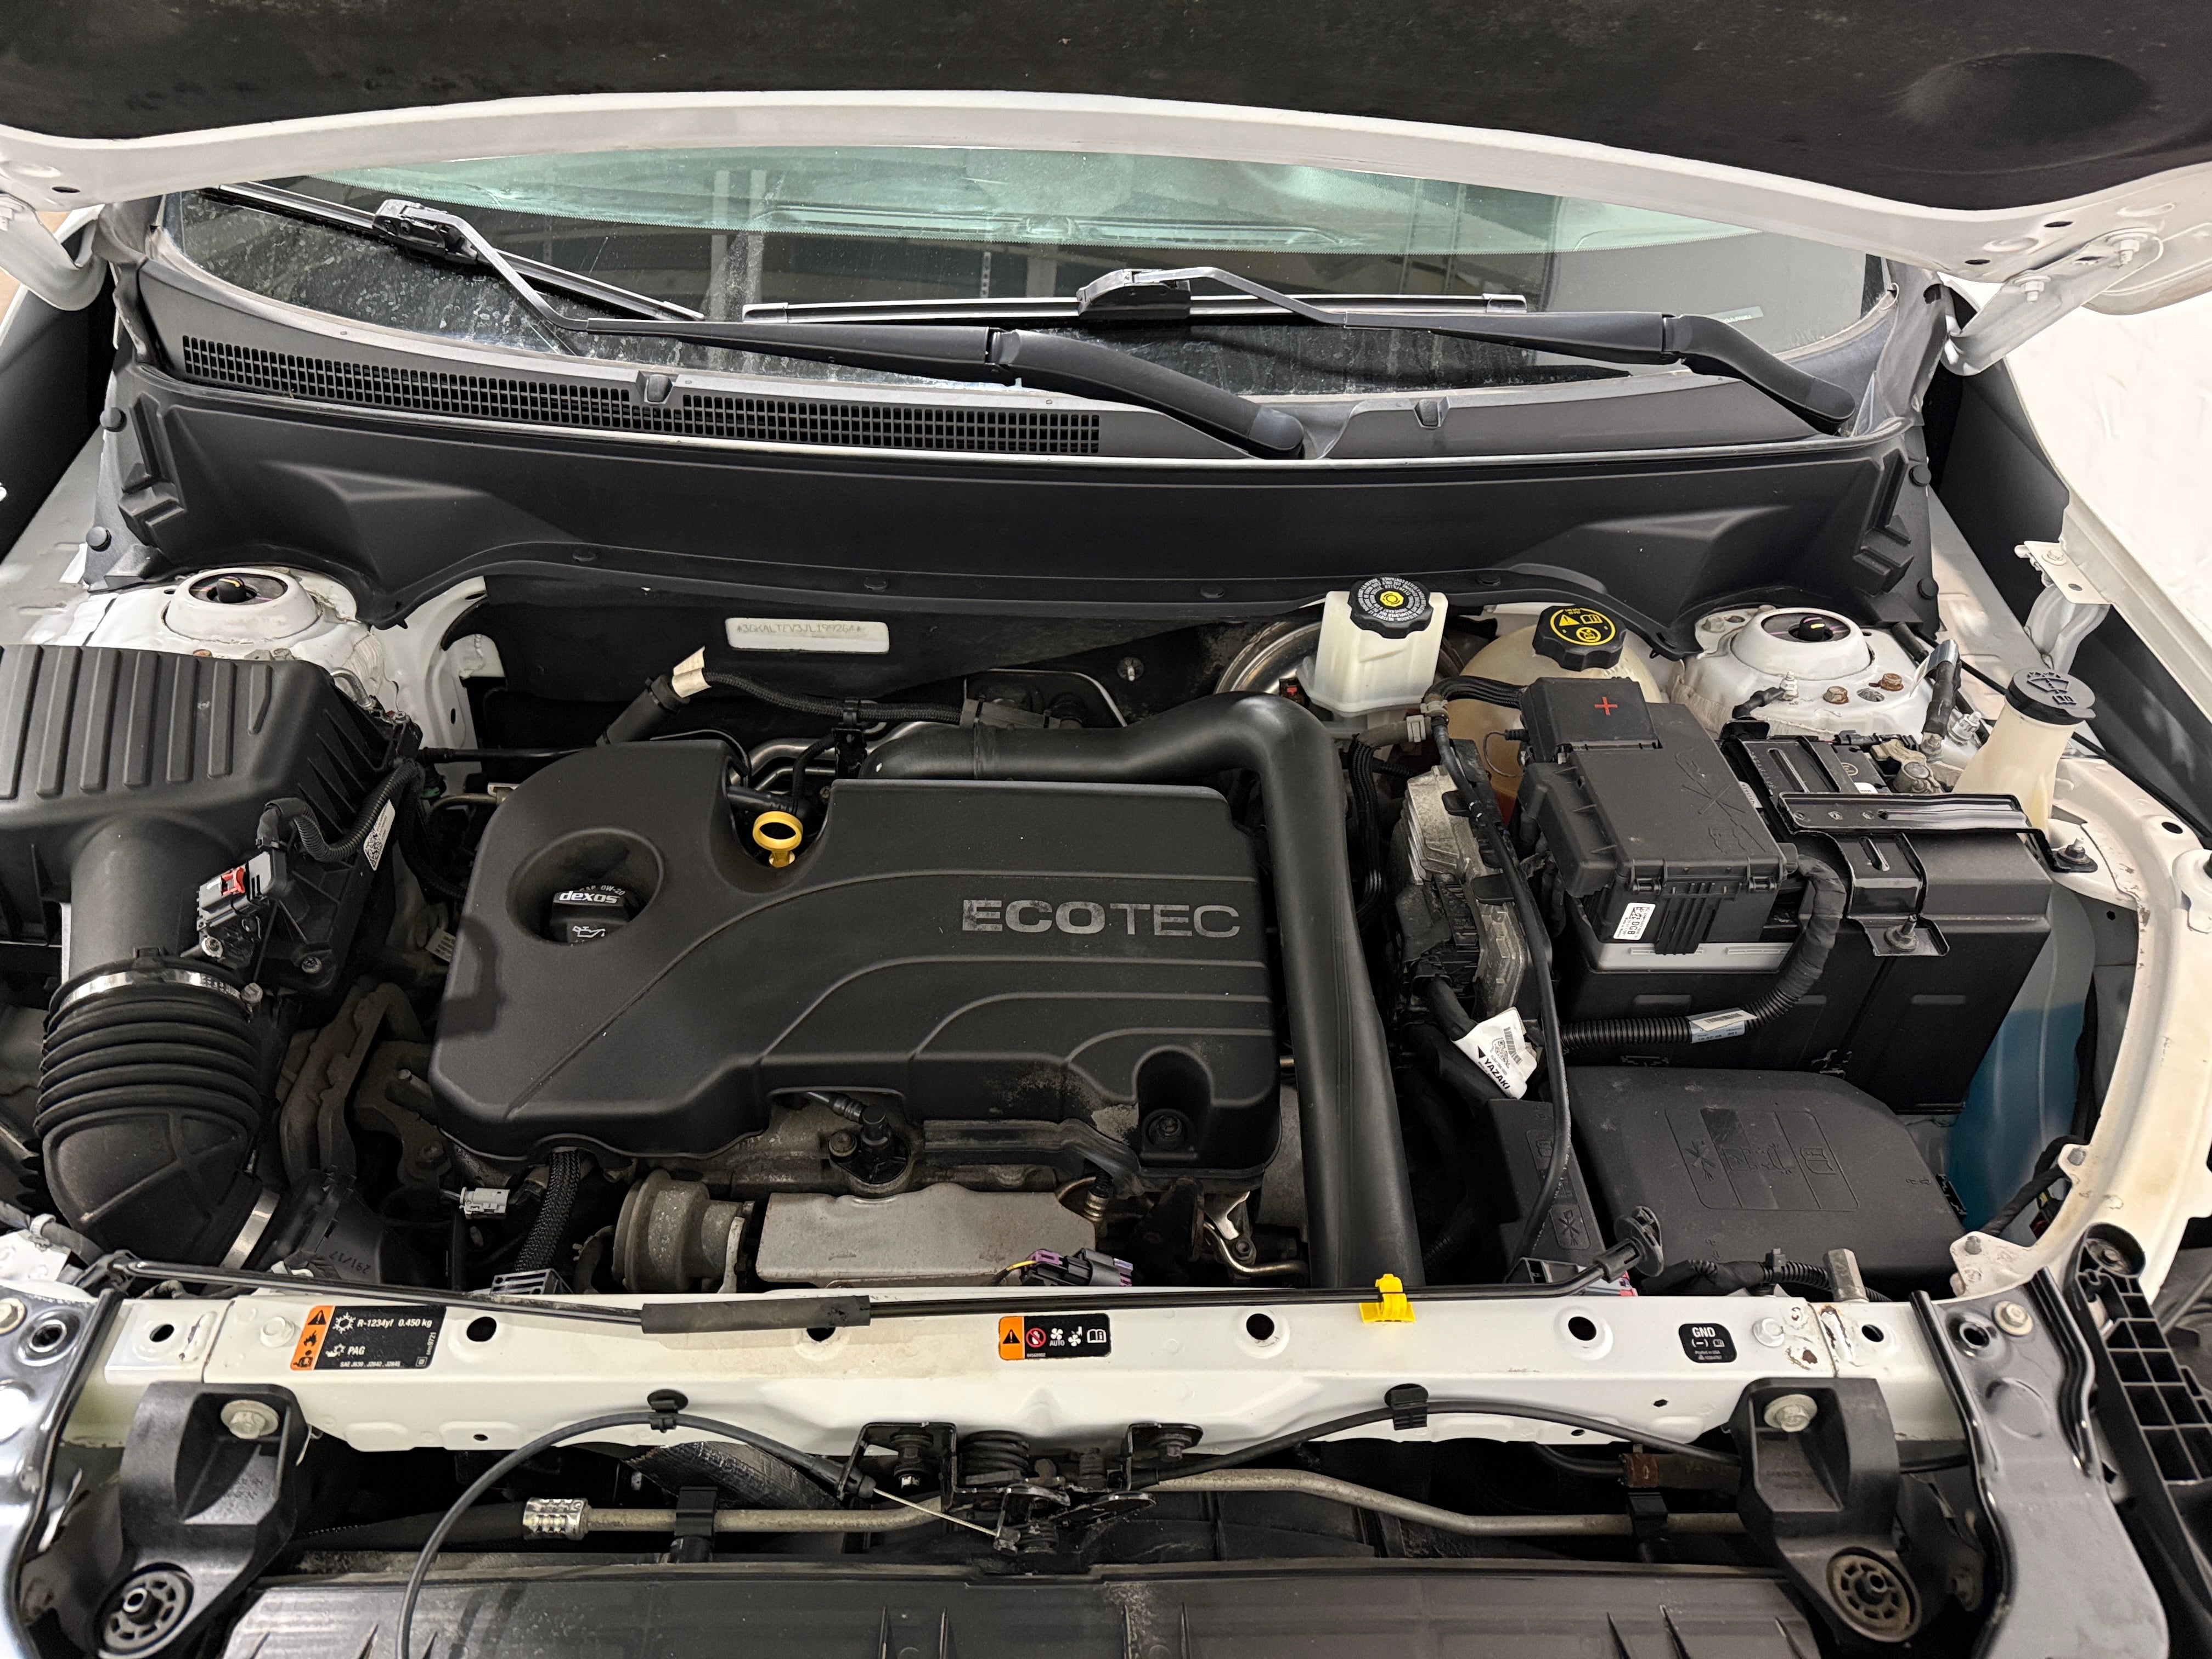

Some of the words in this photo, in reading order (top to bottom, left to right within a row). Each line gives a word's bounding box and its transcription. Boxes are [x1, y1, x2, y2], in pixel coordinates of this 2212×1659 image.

[600, 885, 626, 896] 0W-20
[559, 890, 620, 904] dexos
[962, 899, 1240, 938] ECOTEC
[1484, 1058, 1510, 1090] YAZAKI
[357, 1318, 394, 1329] R-1234yf
[398, 1318, 420, 1327] 0.450
[421, 1318, 433, 1328] kg
[1692, 1327, 1716, 1338] GND
[347, 1346, 365, 1355] PAG
